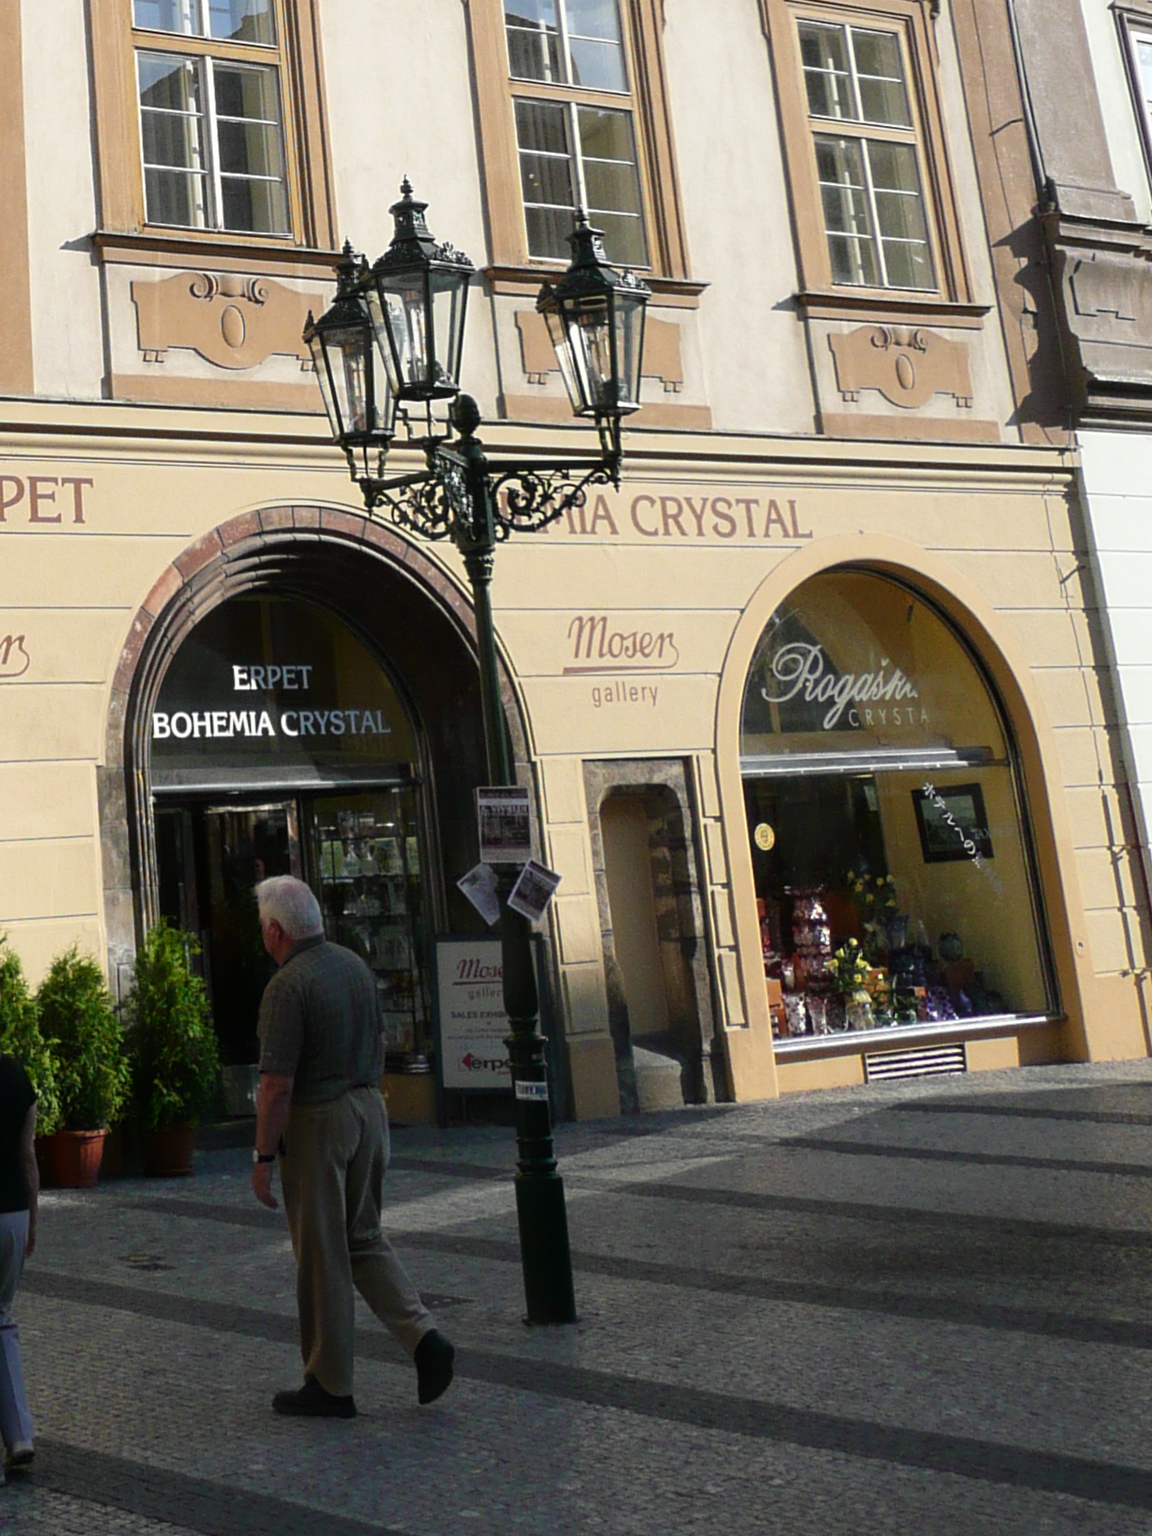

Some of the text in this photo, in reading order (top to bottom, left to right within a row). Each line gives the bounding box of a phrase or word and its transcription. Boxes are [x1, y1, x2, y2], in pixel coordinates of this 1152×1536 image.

[630, 494, 814, 539] CRYSTAL
[565, 615, 679, 670] Moser
[232, 665, 312, 690] ERPET
[761, 642, 918, 729] Rogašk
[591, 680, 658, 708] gallery
[152, 710, 392, 738] BOHEMIA CRYSTAL
[455, 958, 504, 982] Mose
[468, 985, 503, 1000] galler
[471, 1058, 512, 1072] erpe
